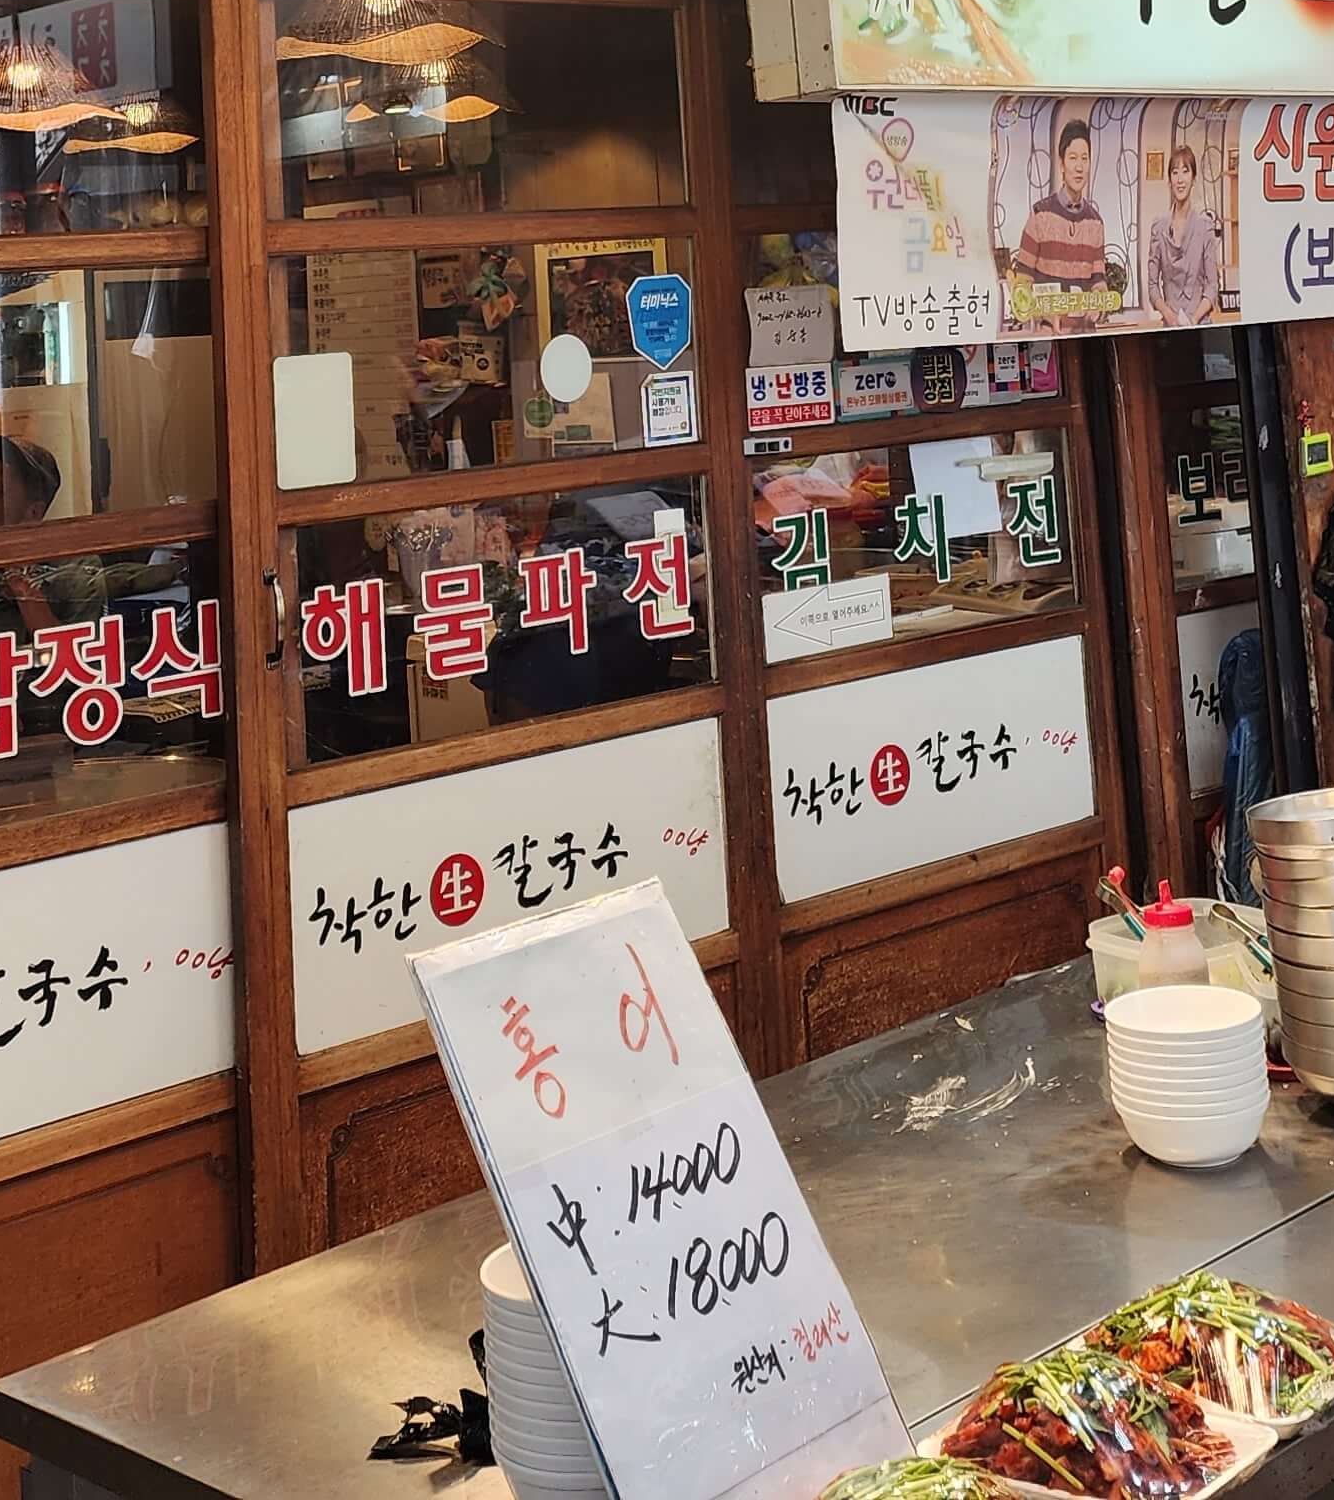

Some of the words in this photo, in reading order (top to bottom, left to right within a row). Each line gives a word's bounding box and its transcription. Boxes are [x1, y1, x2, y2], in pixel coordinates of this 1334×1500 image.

[852, 282, 991, 336] TV방송출현
[771, 475, 1064, 591] 김치전
[301, 534, 696, 697] 해물파전
[783, 760, 867, 827] 착한
[875, 754, 907, 800] 生
[914, 727, 1019, 795] 칼국수
[308, 875, 423, 957] 착한
[437, 866, 478, 918] 生
[491, 820, 632, 910] 칼국수
